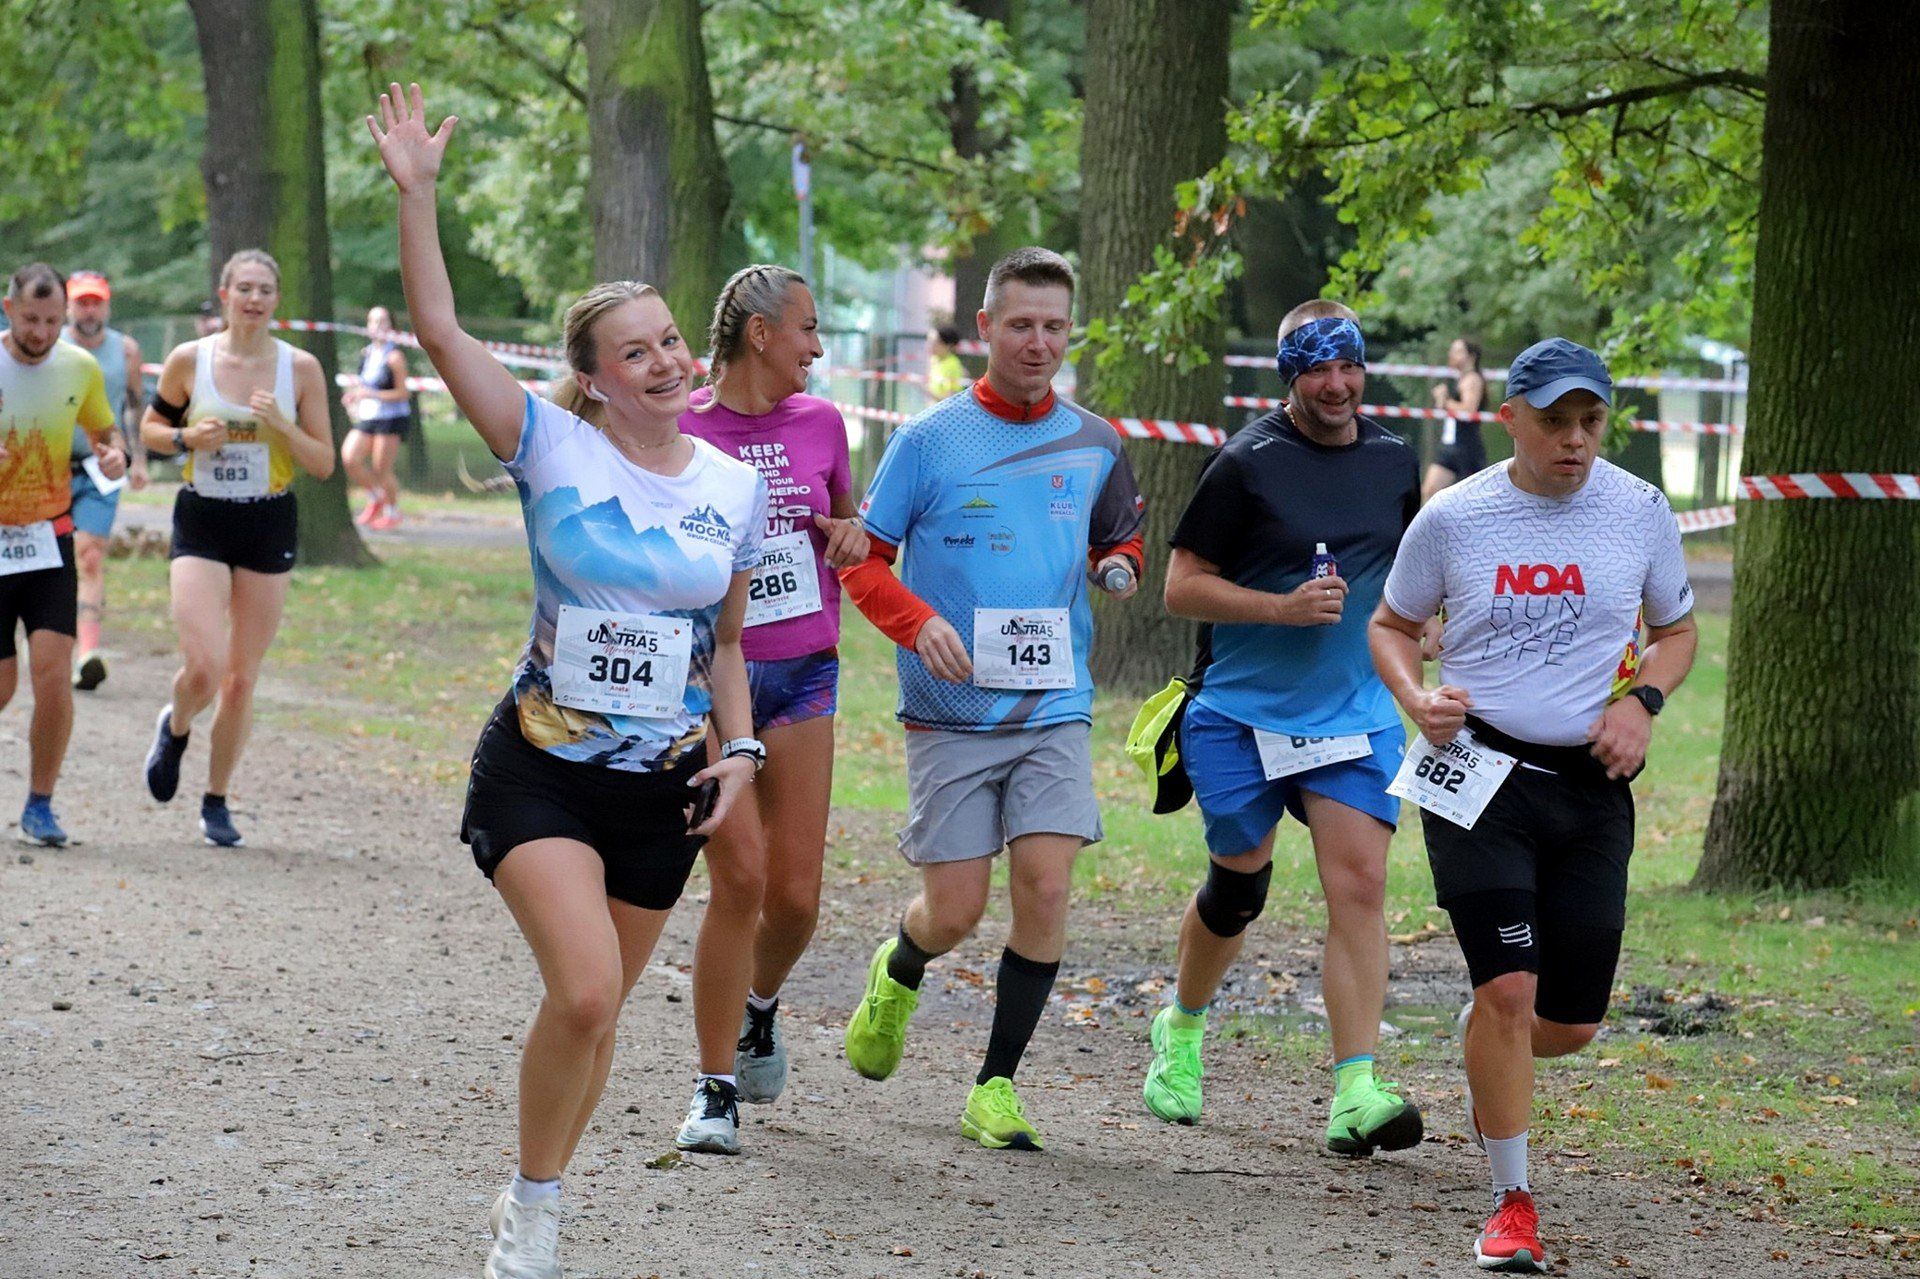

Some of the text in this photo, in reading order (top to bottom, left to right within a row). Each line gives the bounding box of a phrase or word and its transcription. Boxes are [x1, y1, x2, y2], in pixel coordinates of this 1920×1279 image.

[739, 443, 785, 458] KEEP
[214, 467, 248, 480] 683
[770, 477, 794, 486] YOUR
[768, 504, 812, 518] IG
[765, 518, 795, 536] UN
[2, 544, 37, 560] 480
[749, 570, 798, 601] 286
[1494, 563, 1586, 595] NOA
[1491, 596, 1586, 621] RUN
[1489, 621, 1578, 642] YOUR
[1007, 643, 1051, 666] 143
[1482, 639, 1572, 666] LIFE
[588, 654, 654, 687] 304
[1414, 755, 1466, 795] 682
